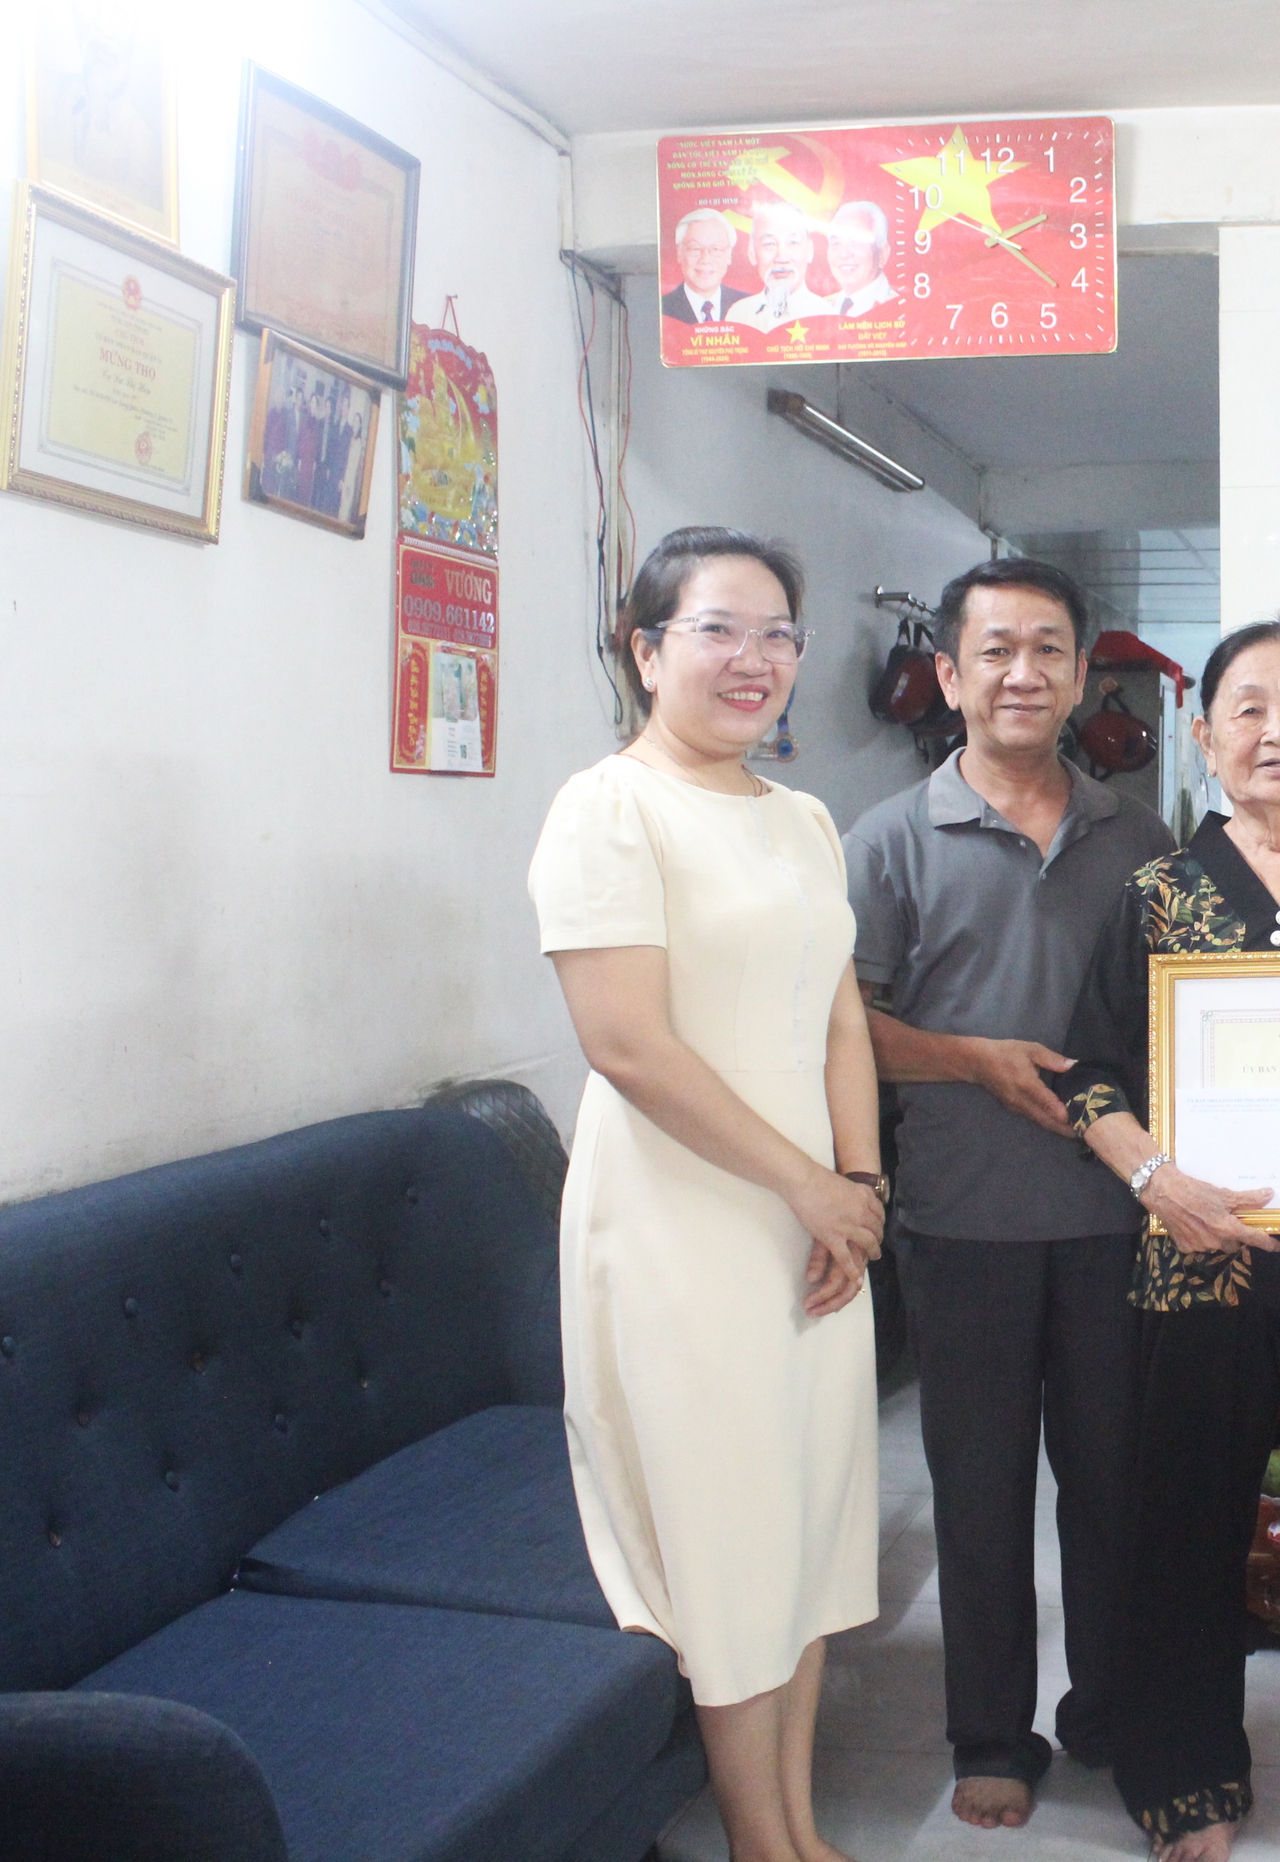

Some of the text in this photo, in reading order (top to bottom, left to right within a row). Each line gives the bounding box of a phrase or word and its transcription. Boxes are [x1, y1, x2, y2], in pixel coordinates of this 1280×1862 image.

[936, 148, 1014, 175] 11 12
[1044, 147, 1054, 172] 1
[909, 184, 942, 210] 10
[1069, 177, 1087, 203] 2
[914, 229, 931, 254] 9
[1069, 223, 1087, 249] 3
[913, 272, 931, 299] 8
[1071, 267, 1089, 293] 4
[838, 322, 855, 330] LÀM
[856, 321, 872, 329] NÊN
[874, 321, 892, 330] LỊCH
[946, 304, 963, 330] 7
[991, 303, 1008, 328] 6
[1040, 303, 1057, 329] 5
[690, 333, 740, 346] VĨ NHÂN
[872, 331, 886, 339] VIỆT
[99, 346, 156, 382] MỪNG THỌ
[404, 594, 494, 633] 0909.661142
[1243, 1063, 1256, 1073] ỦY
[1258, 1065, 1277, 1073] BAN
